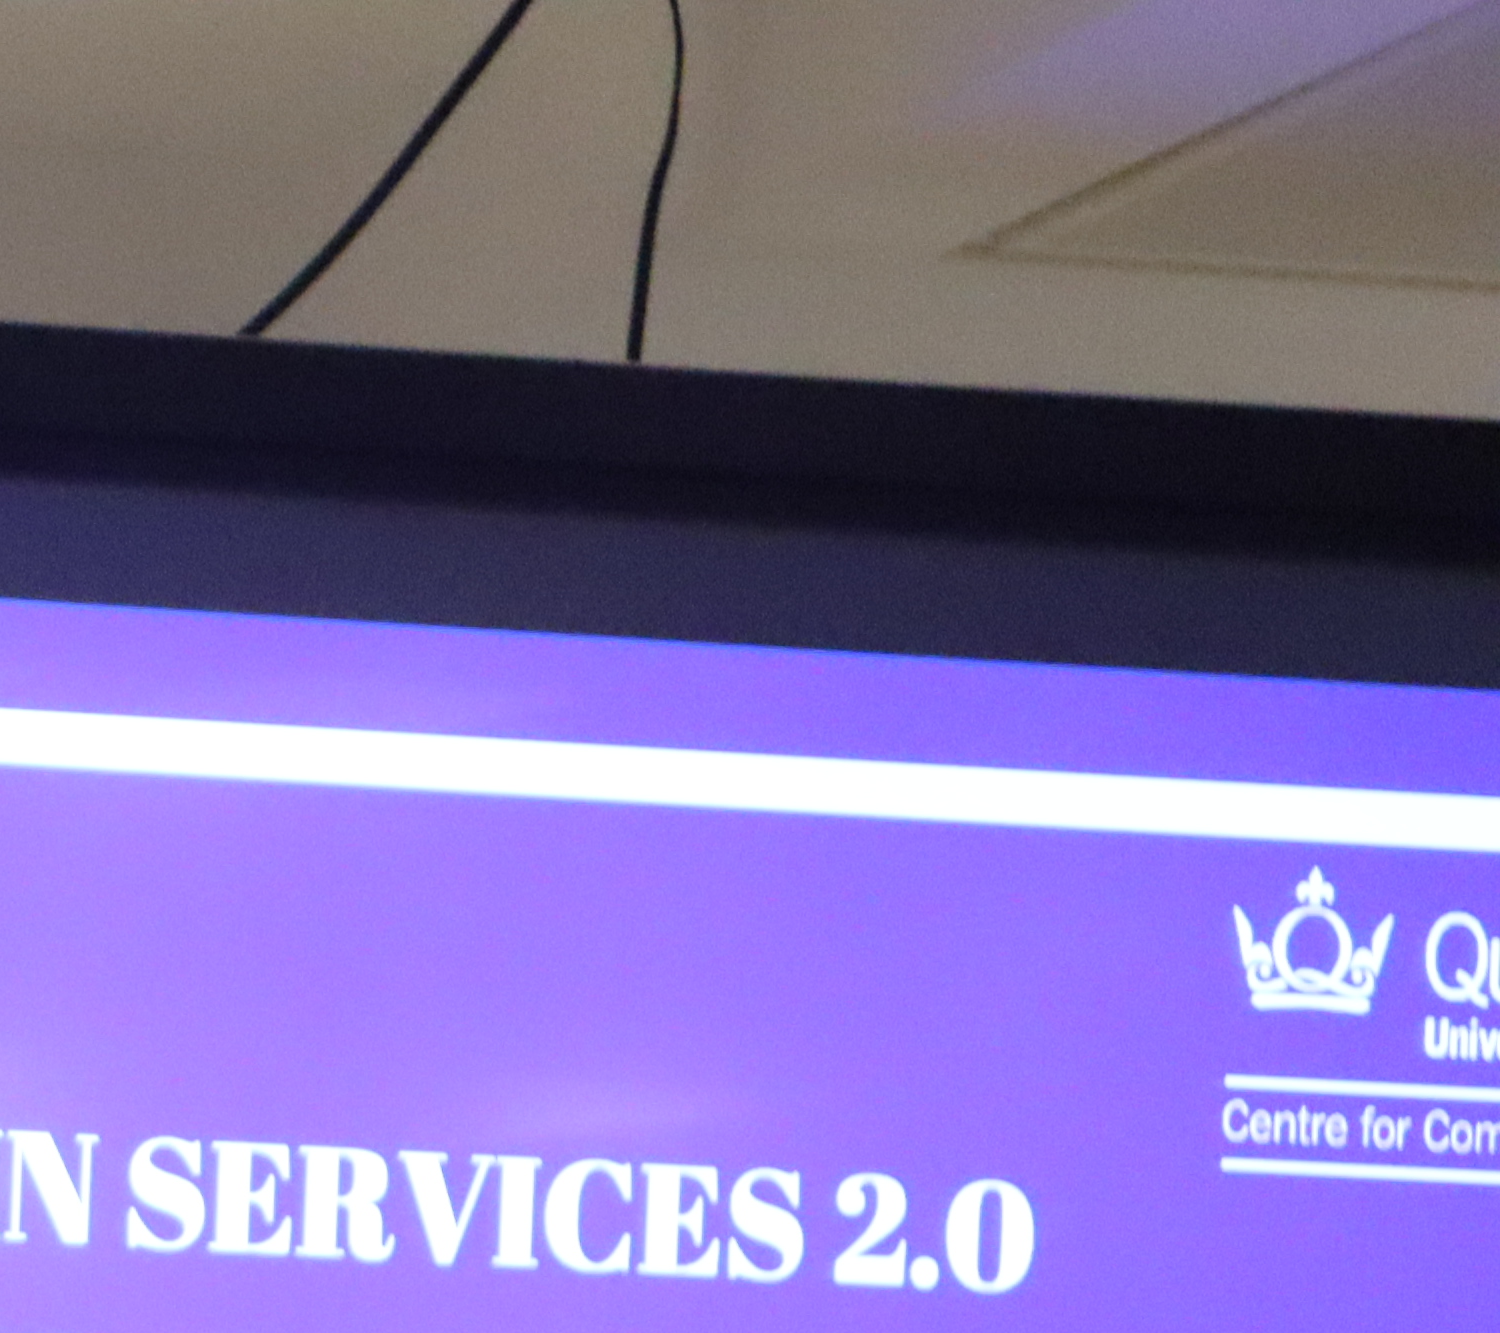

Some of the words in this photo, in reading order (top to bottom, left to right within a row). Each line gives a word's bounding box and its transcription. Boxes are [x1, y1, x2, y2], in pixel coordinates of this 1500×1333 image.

[1222, 1098, 1348, 1149] Centre
[1360, 1104, 1412, 1151] for
[126, 1136, 803, 1282] SERVICES
[833, 1173, 1034, 1293] 2.0
